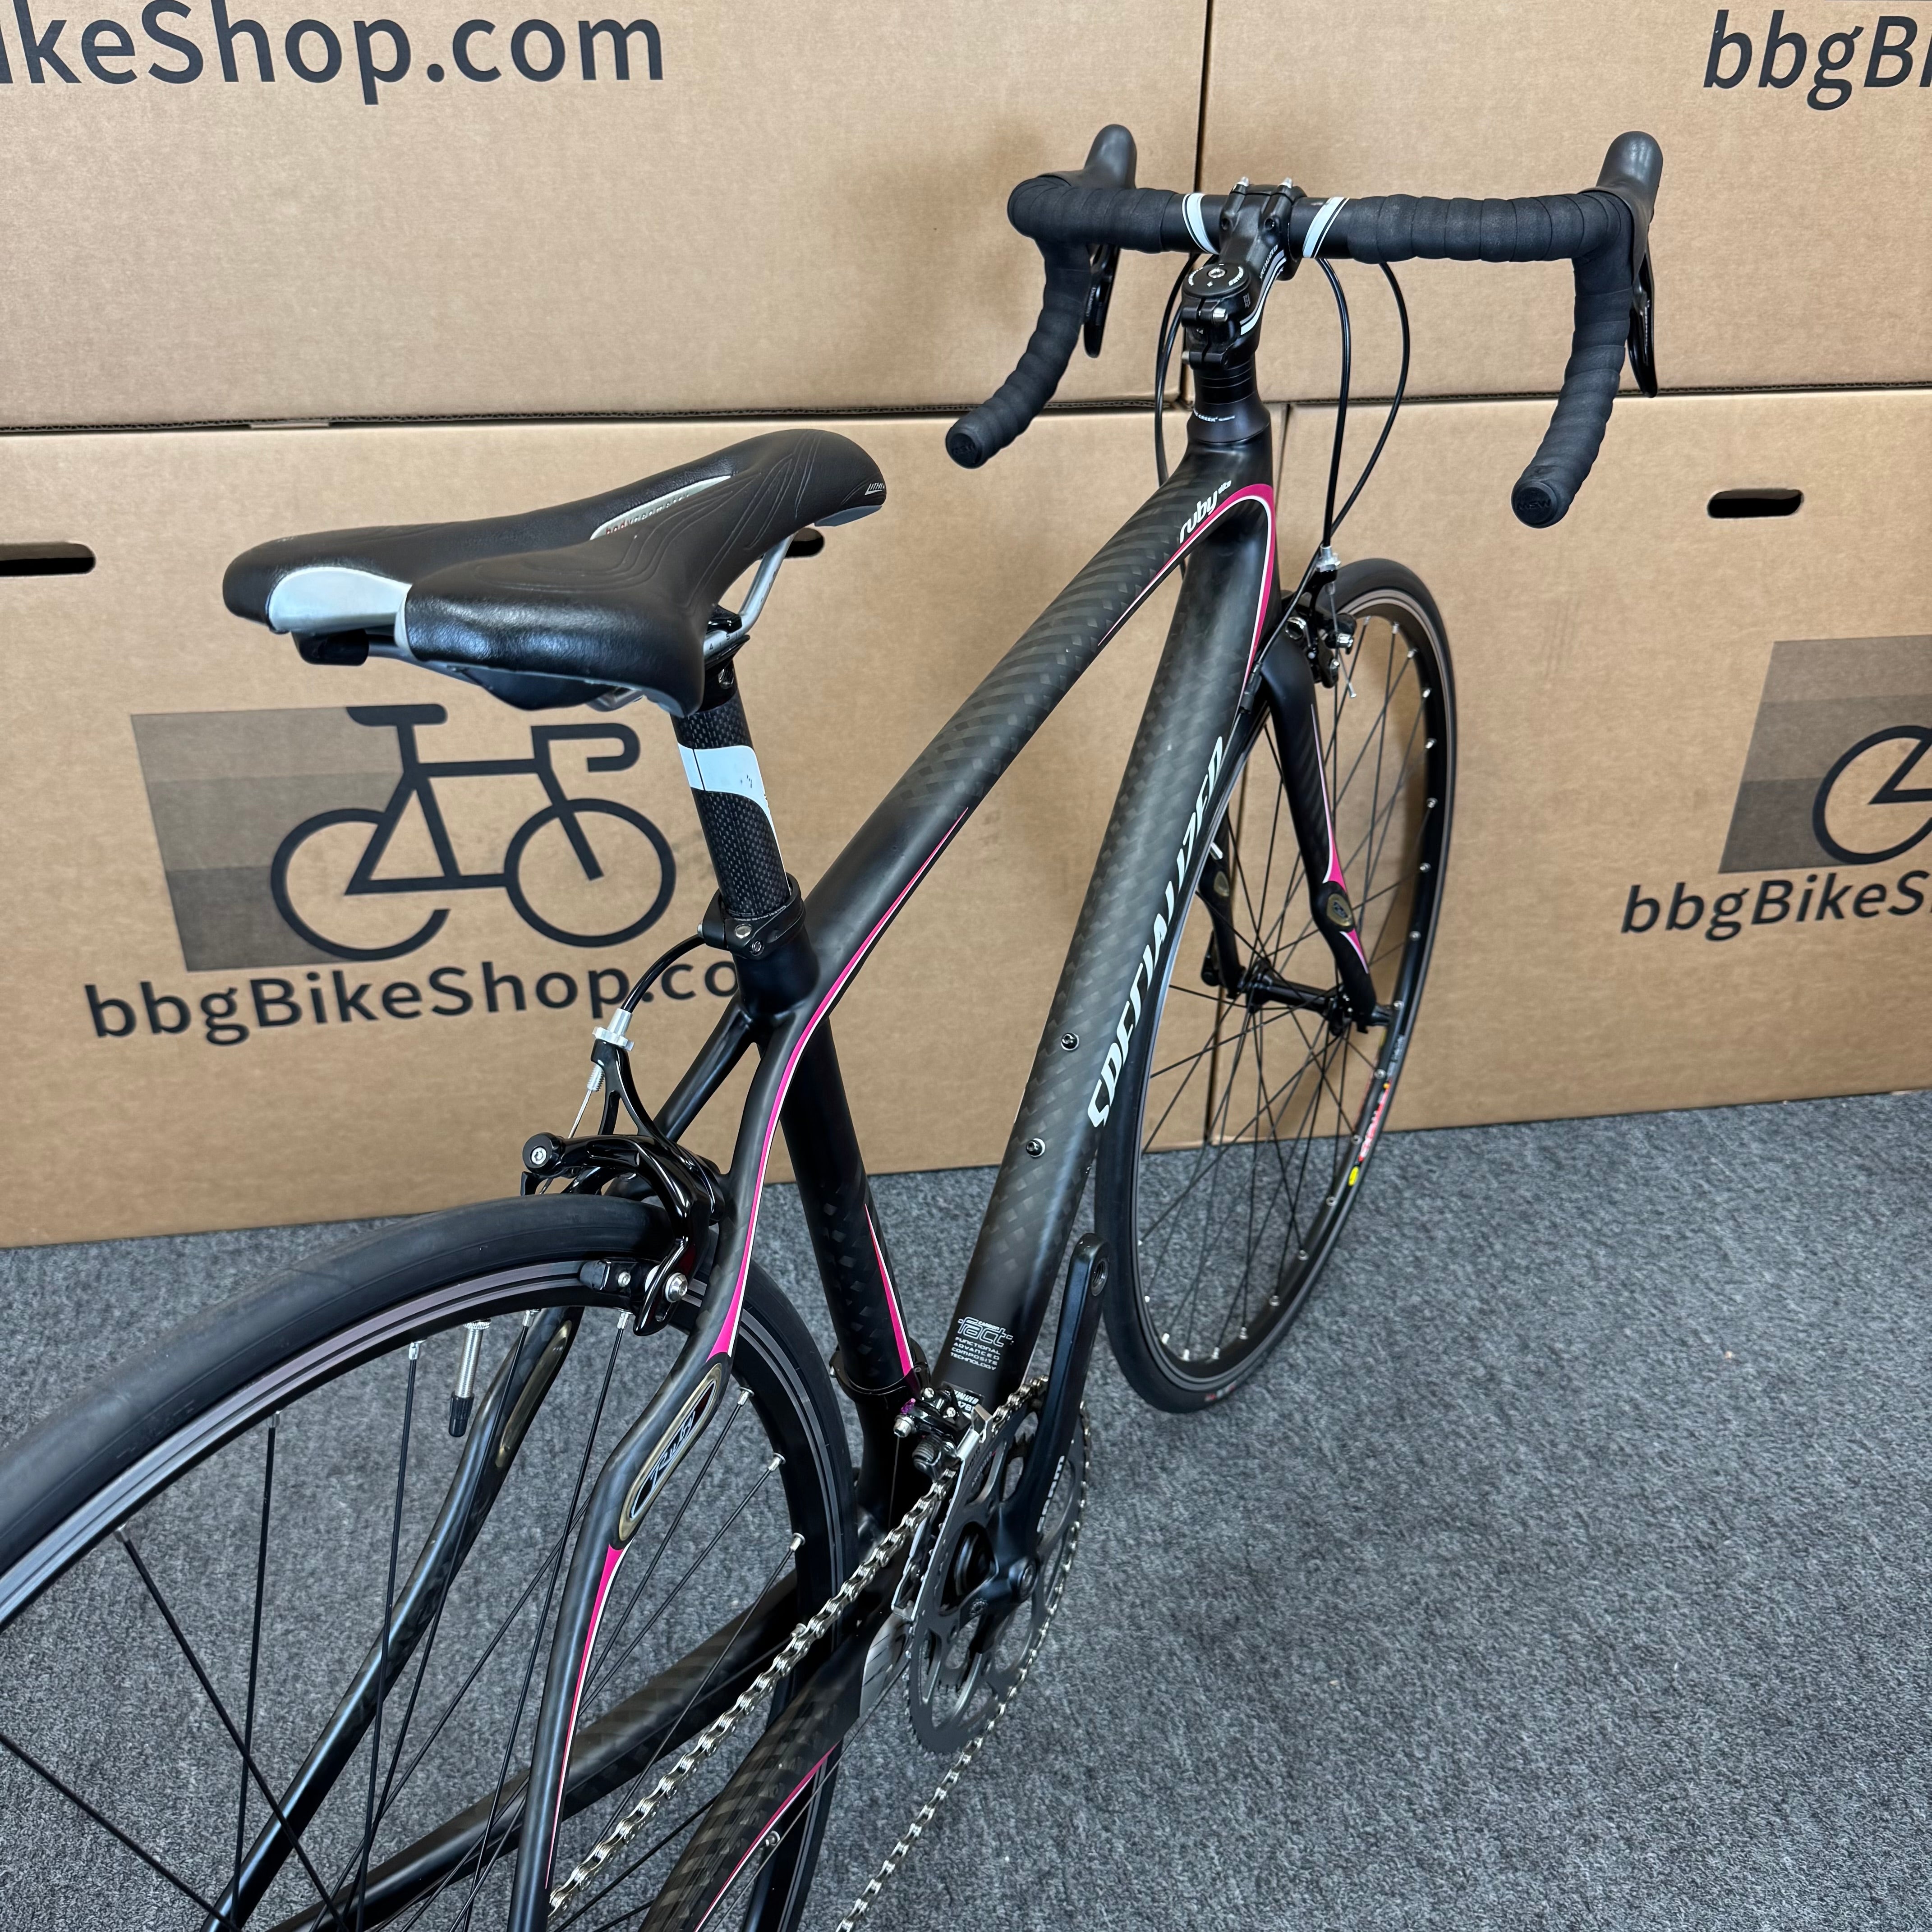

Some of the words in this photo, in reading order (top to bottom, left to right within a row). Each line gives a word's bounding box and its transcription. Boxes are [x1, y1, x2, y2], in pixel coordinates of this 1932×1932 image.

[1180, 490, 1218, 544] ruby
[1621, 870, 1932, 941] bbgBikeS
[953, 1342, 1000, 1360] ADVANCED
